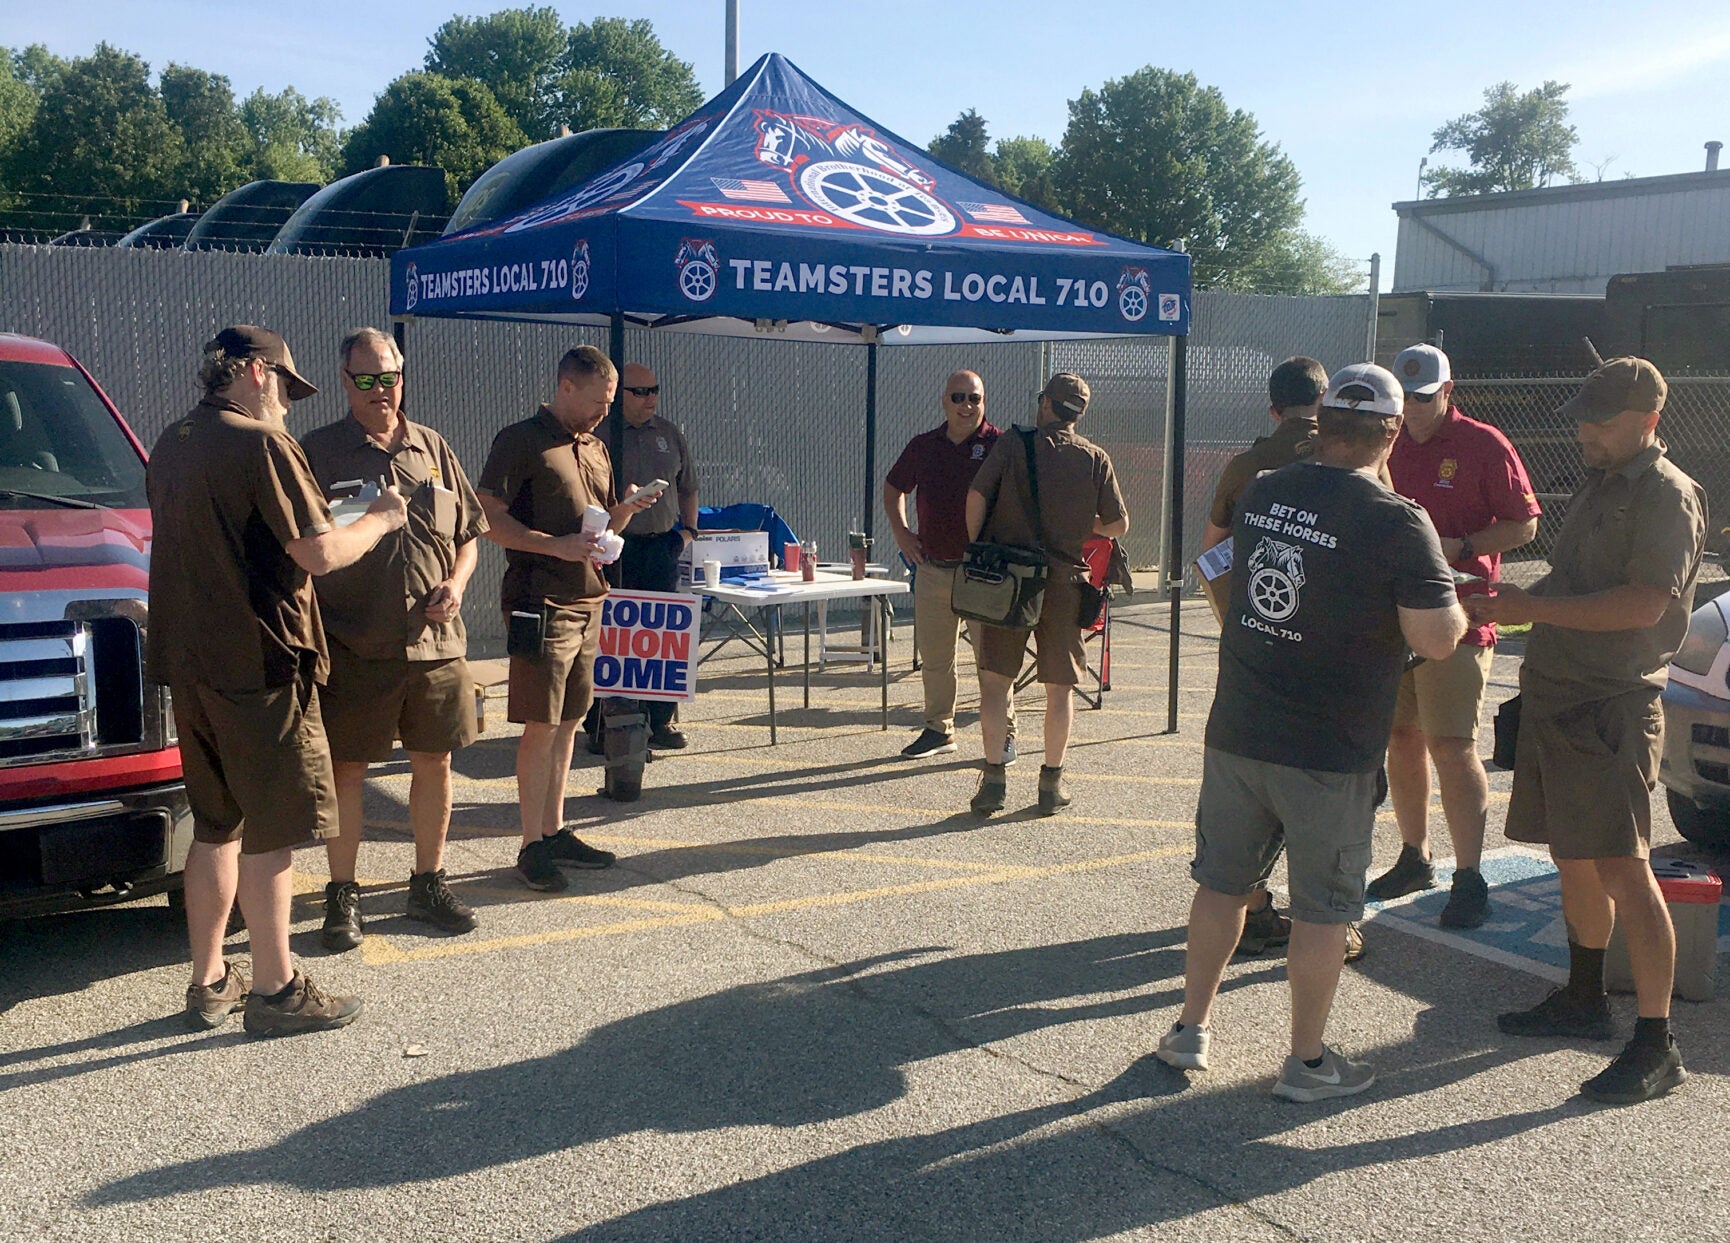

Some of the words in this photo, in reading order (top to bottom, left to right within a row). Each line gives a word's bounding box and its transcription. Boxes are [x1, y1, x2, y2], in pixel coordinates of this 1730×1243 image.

[700, 205, 797, 223] PROUD
[798, 213, 833, 225] TO
[974, 227, 1010, 239] BE
[420, 266, 491, 299] TEAMSTERS
[493, 260, 538, 294] LOCAL
[541, 258, 569, 289] 710
[729, 259, 933, 299] TEAMSTERS
[944, 271, 1046, 305] LOCAL
[1056, 278, 1109, 308] 710
[1244, 512, 1282, 532] THESE
[1282, 523, 1338, 549] HORSES
[1269, 503, 1296, 519] BET
[1296, 511, 1318, 526] ON
[599, 627, 690, 660] NION
[1241, 614, 1278, 636] LOCAL
[1279, 628, 1303, 642] 710
[594, 656, 688, 691] OME
